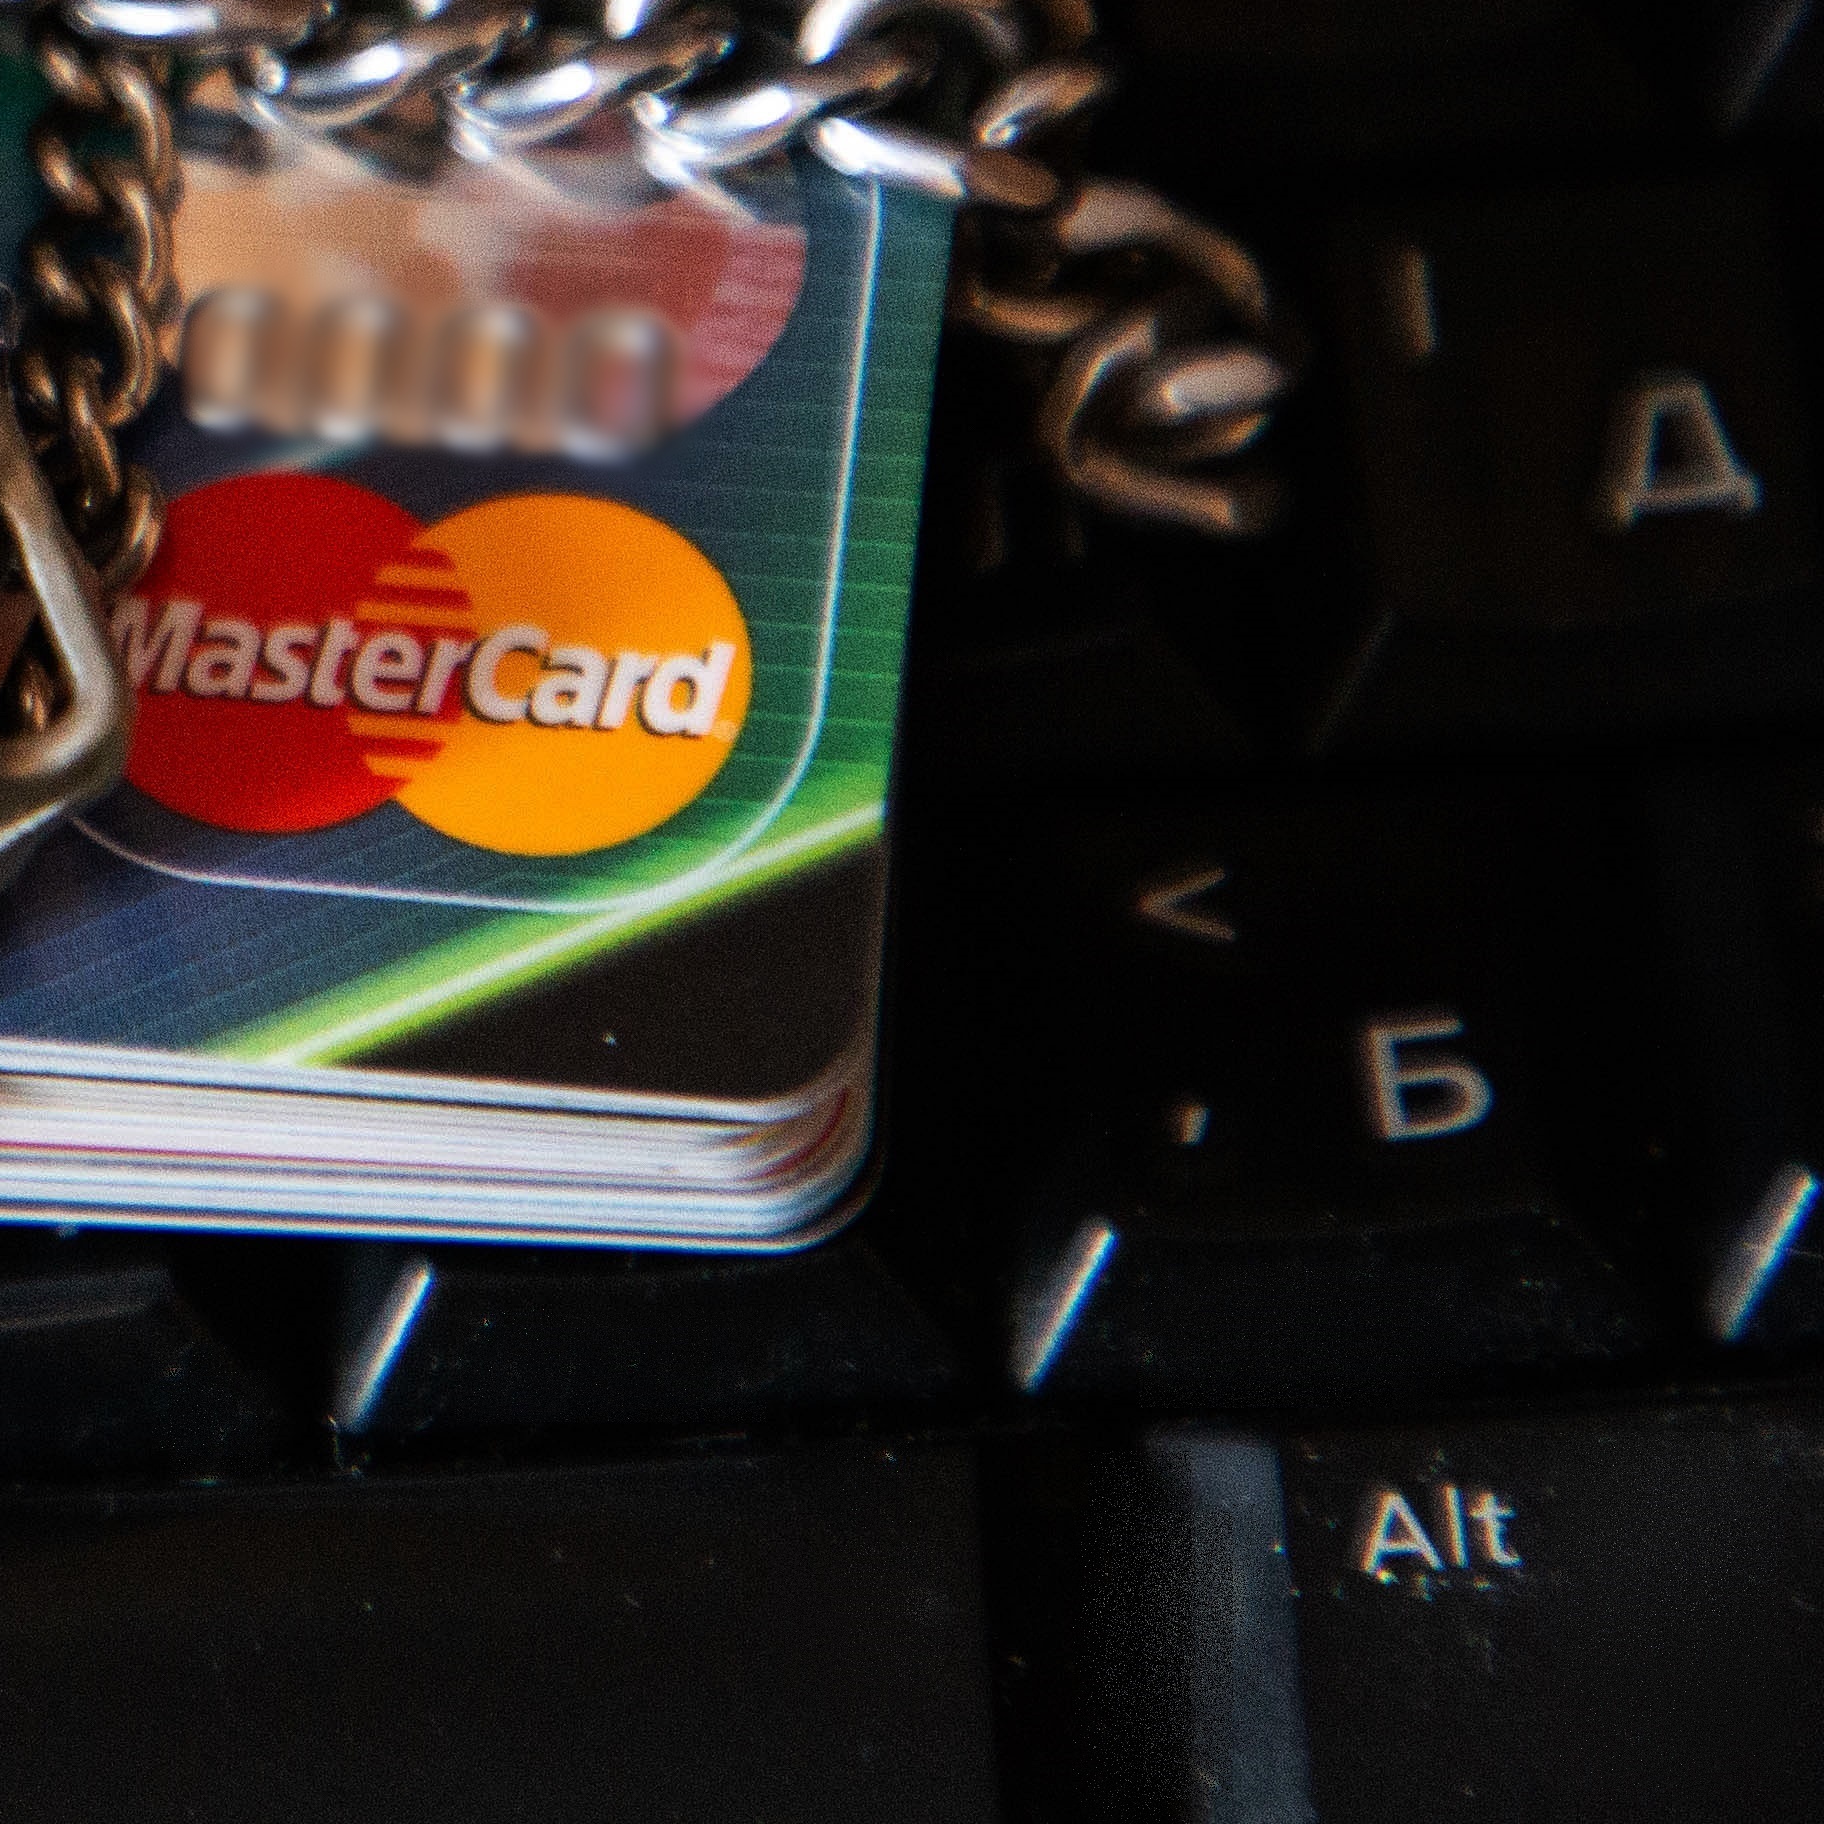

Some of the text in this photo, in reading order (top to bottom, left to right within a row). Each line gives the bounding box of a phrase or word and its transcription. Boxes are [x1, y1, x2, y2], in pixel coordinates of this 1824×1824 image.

[108, 592, 738, 737] MasterCard
[1358, 1005, 1497, 1142] Б
[1360, 1483, 1523, 1573] Alt
